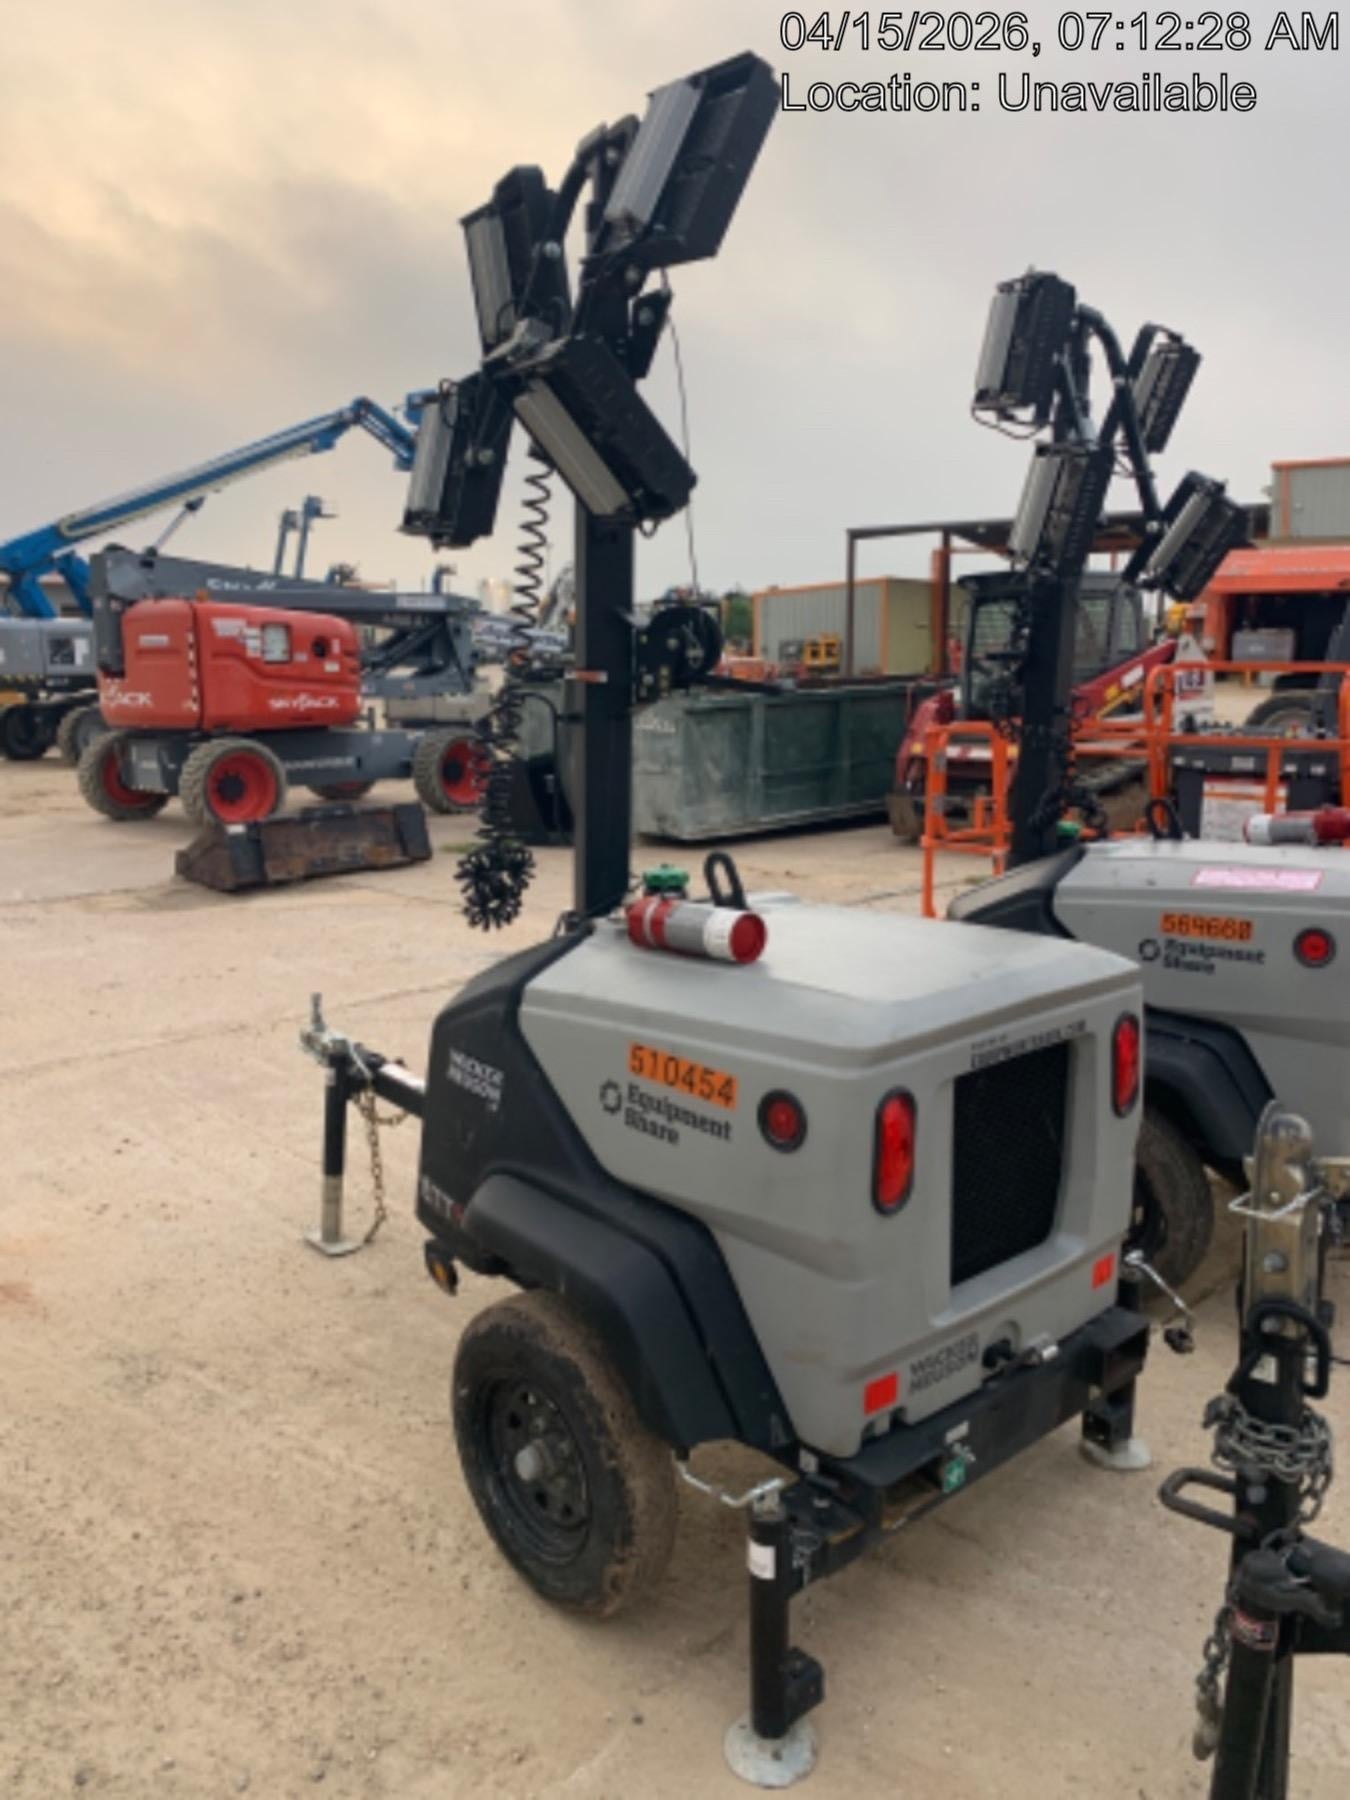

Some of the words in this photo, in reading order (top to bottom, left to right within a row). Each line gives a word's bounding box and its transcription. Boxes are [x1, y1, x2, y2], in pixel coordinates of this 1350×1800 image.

[631, 1044, 735, 1109] 510454
[624, 1107, 680, 1146] Share
[627, 1082, 733, 1141] Equipment
